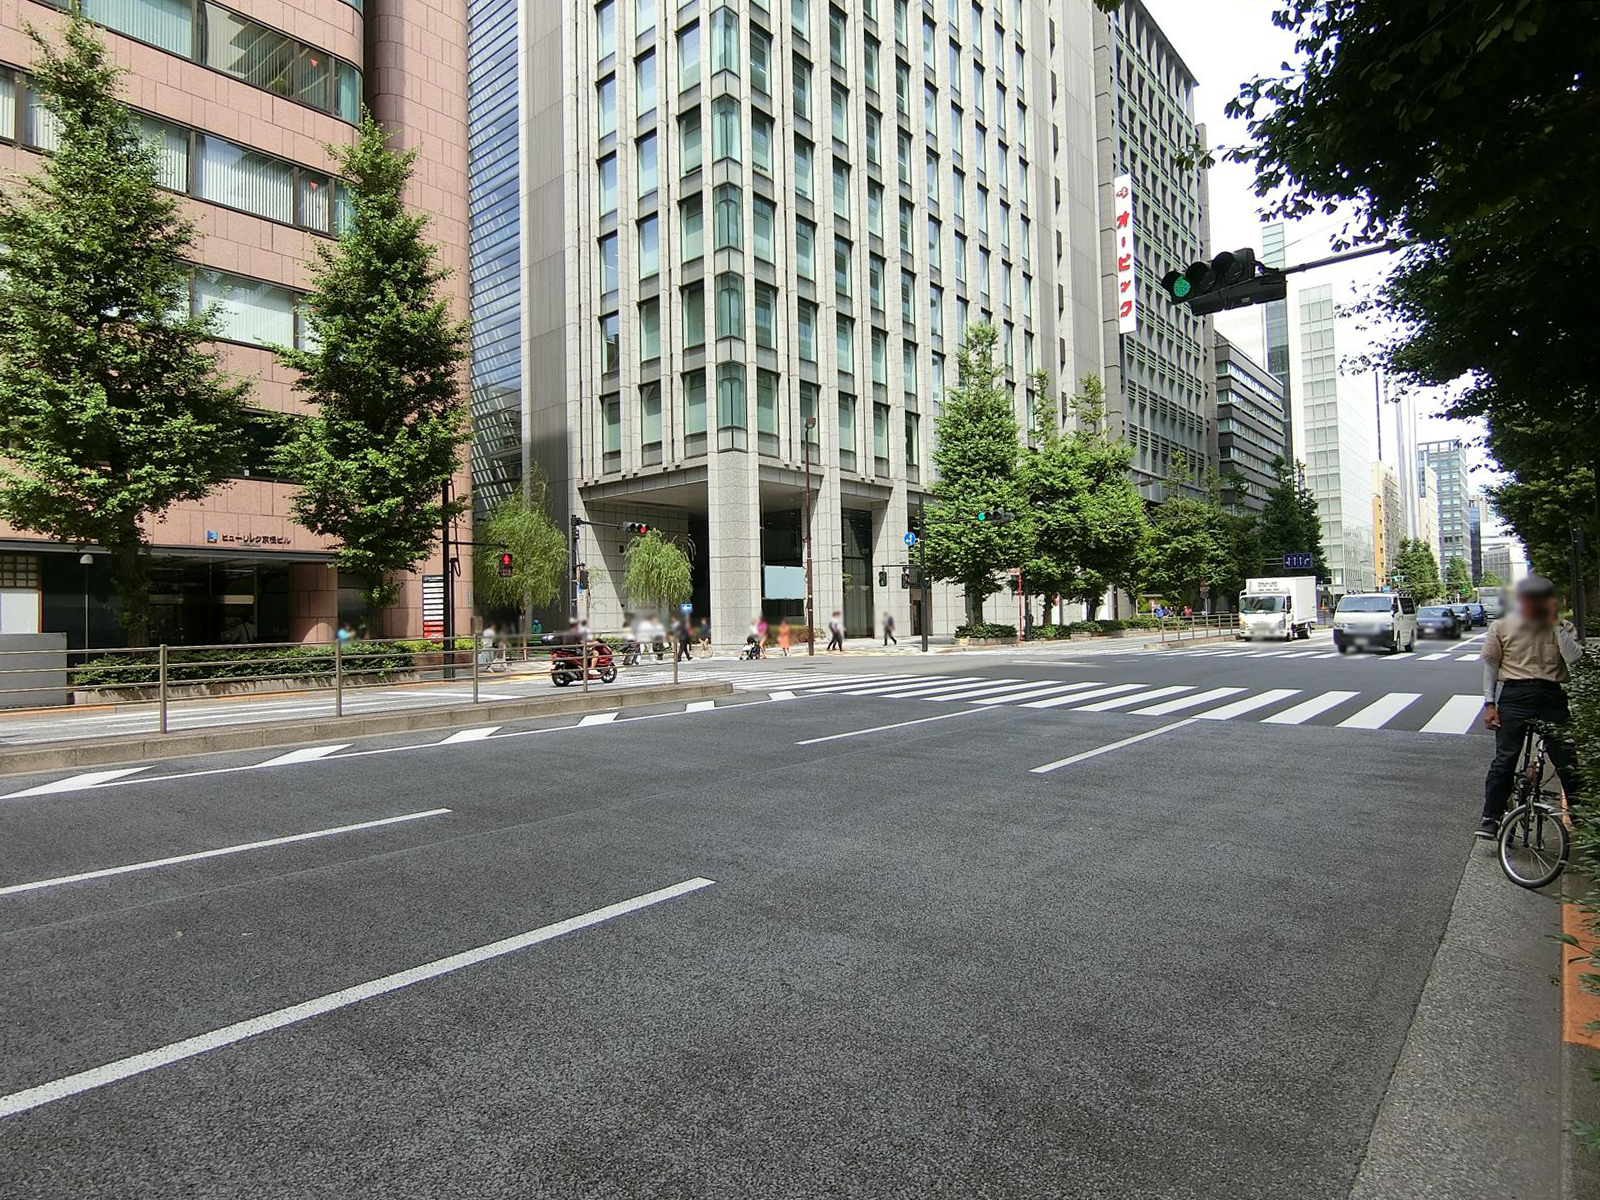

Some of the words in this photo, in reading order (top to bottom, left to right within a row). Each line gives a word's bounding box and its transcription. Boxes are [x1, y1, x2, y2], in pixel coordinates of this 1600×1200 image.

[1116, 210, 1133, 318] オービック
